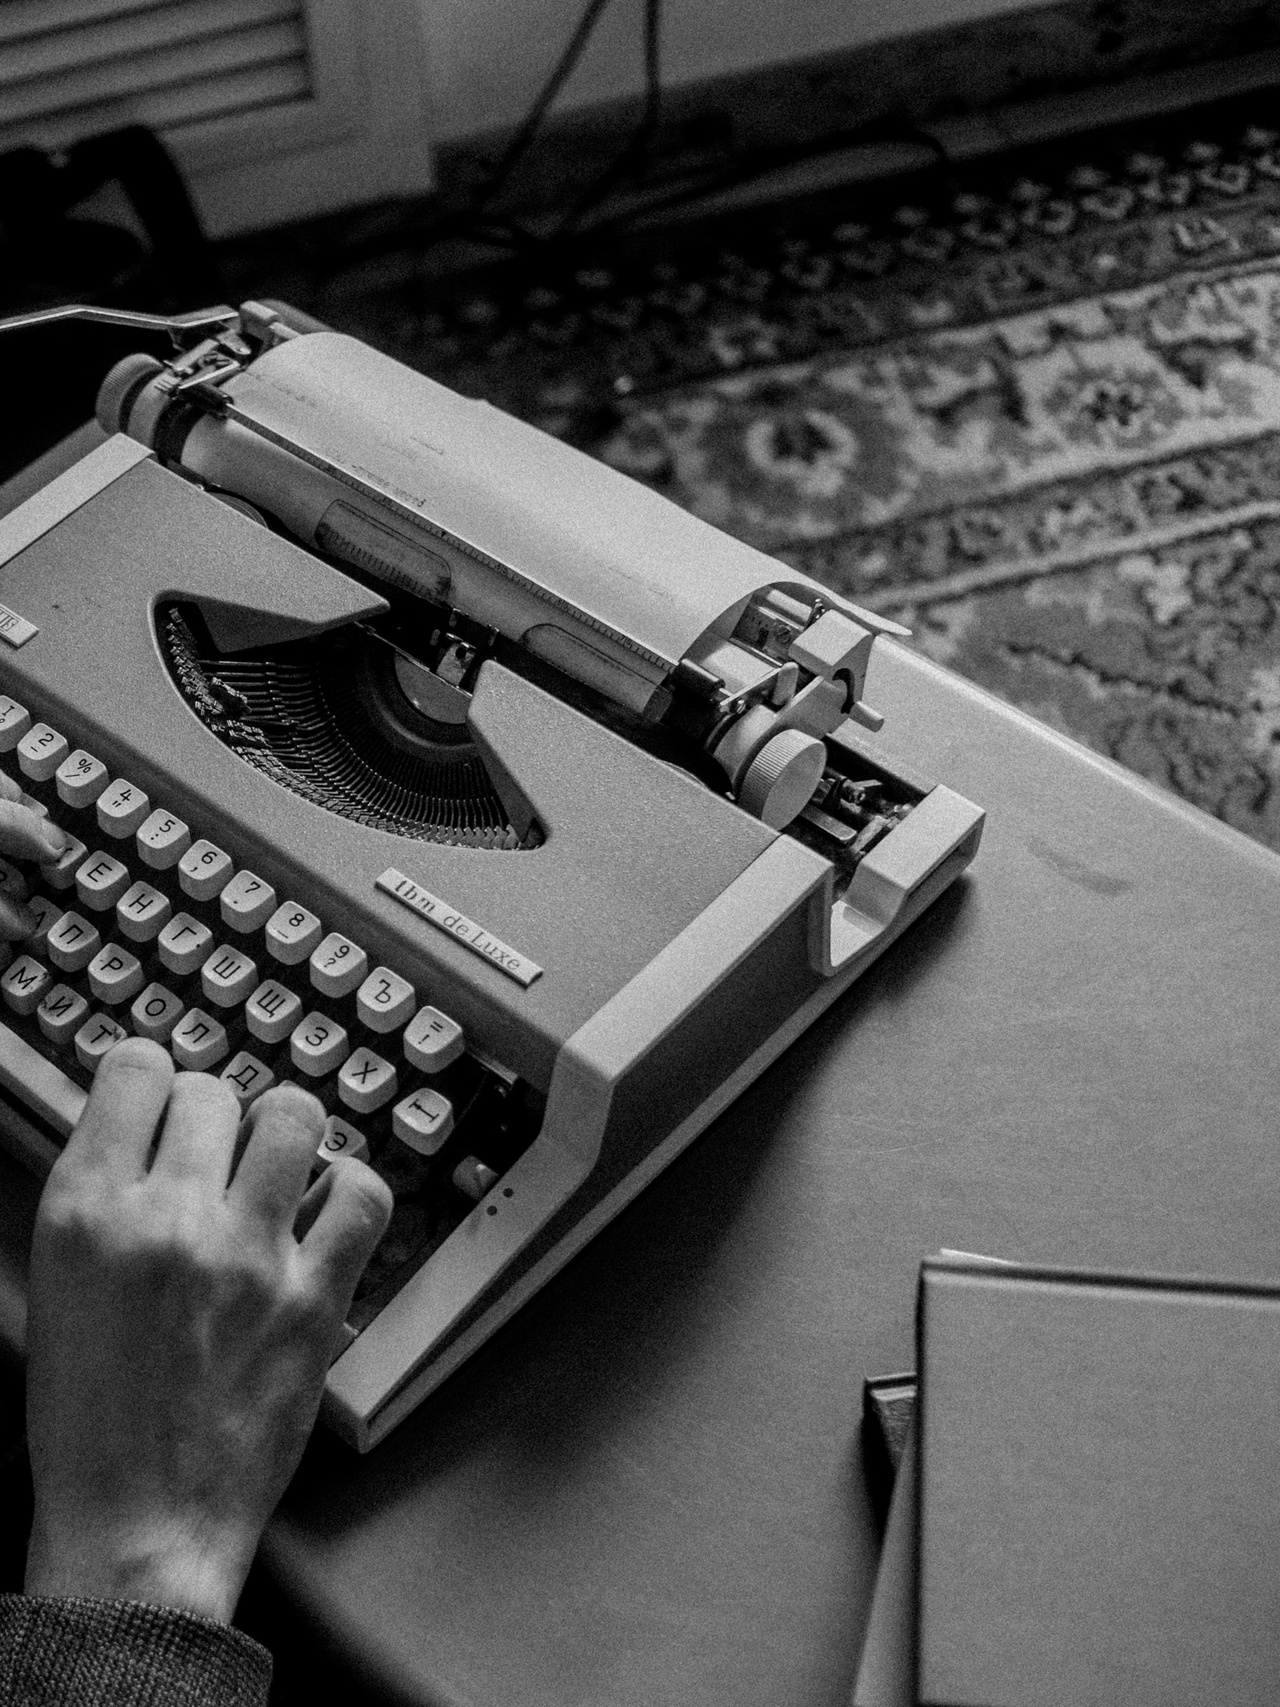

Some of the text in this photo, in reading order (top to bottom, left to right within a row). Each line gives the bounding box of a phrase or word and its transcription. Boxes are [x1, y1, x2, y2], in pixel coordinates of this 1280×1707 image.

[38, 733, 54, 747] 2
[78, 758, 92, 774] %
[159, 819, 176, 833] 5
[201, 851, 218, 865] 6
[244, 881, 261, 894] 7
[289, 913, 305, 927] 8
[59, 924, 84, 944] П
[171, 926, 197, 941] Г
[443, 915, 469, 936] de
[471, 931, 521, 970] Luxe
[335, 944, 350, 959] 9
[212, 955, 241, 980] Ш
[374, 979, 391, 1004] Ъ
[48, 995, 73, 1017] И
[256, 989, 286, 1018] Щ
[182, 1022, 210, 1043] Л
[226, 1064, 259, 1092] Д
[324, 1131, 348, 1151] Э
